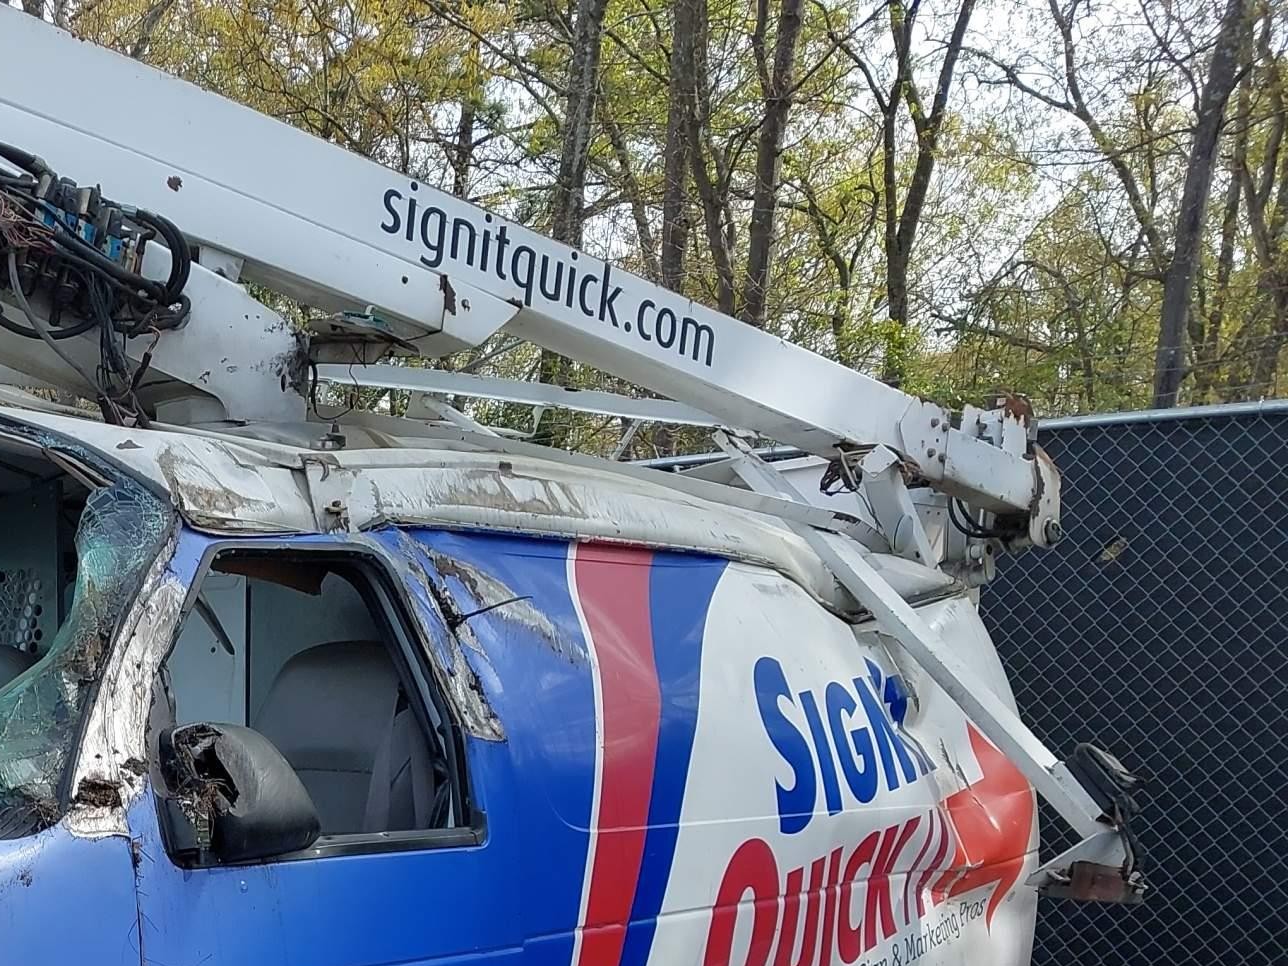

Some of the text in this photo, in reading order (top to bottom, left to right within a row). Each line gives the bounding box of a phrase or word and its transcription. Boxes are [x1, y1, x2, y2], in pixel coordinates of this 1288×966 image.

[380, 181, 715, 367] signitquick.com
[904, 913, 961, 966] Marketing
[959, 897, 987, 927] Pros
